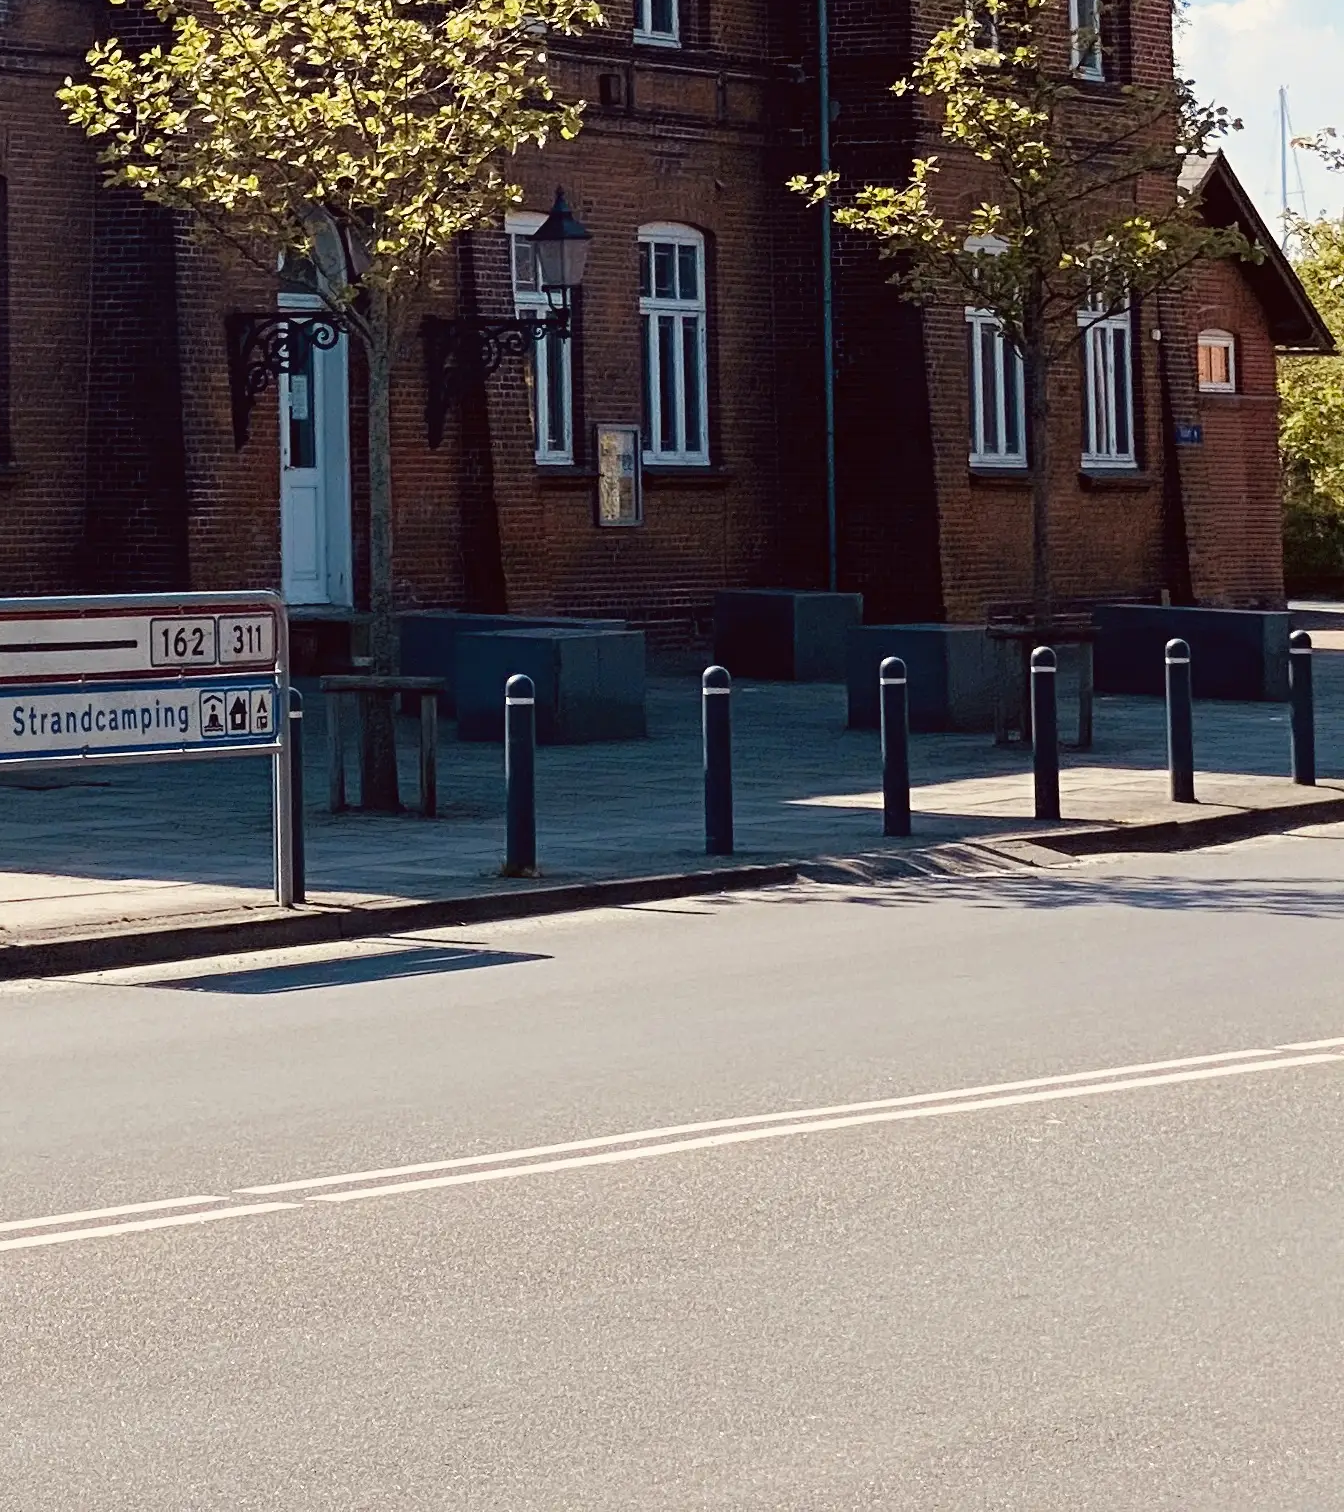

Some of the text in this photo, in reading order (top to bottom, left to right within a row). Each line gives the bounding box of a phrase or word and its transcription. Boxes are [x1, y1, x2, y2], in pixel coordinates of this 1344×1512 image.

[162, 625, 261, 657] 162 311
[12, 699, 189, 737] Strandcamping
